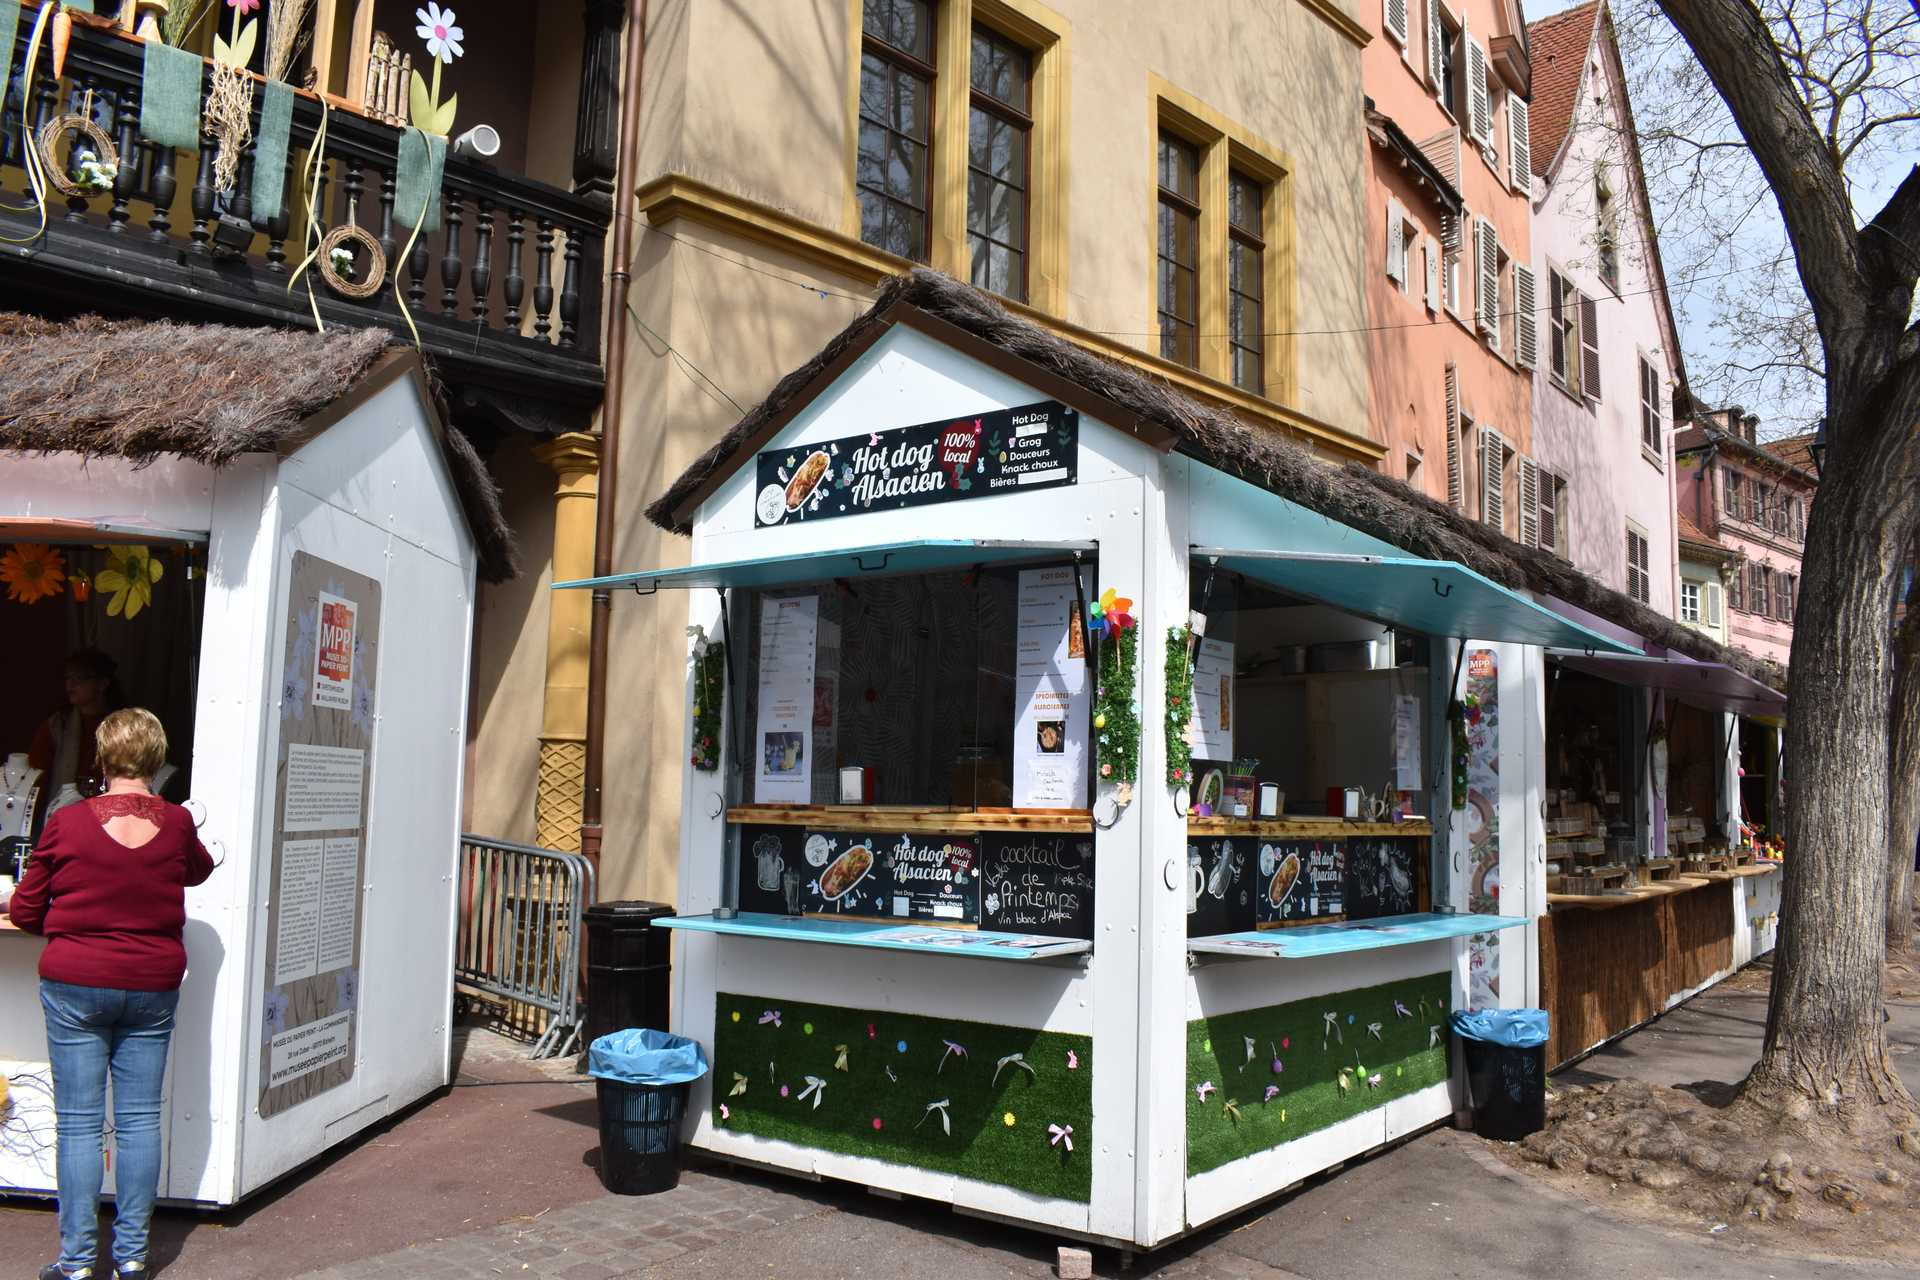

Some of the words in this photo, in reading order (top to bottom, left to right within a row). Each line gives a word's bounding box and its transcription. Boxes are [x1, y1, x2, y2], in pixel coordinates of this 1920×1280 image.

[1012, 415, 1028, 425] Hot
[1030, 413, 1049, 422] Dog
[944, 433, 976, 448] 100%
[1018, 437, 1042, 448] Grog
[852, 446, 888, 474] Hot
[890, 442, 934, 471] dog
[944, 449, 972, 463] local
[1010, 448, 1050, 461] Douceurs
[1001, 462, 1030, 474] Knack
[1031, 459, 1059, 470] choux
[852, 471, 945, 505] Alsacien
[990, 477, 1017, 488] Bières
[322, 624, 351, 652] MPP
[1469, 659, 1490, 668] MPP
[893, 844, 917, 861] Hot
[918, 846, 945, 867] dog
[952, 846, 973, 859] 100%
[1000, 838, 1080, 870] cocktail
[951, 857, 969, 868] local
[893, 862, 953, 882] Alsacien
[1022, 866, 1046, 886] de
[1001, 881, 1080, 922] Printemps
[1015, 912, 1037, 924] blanc
